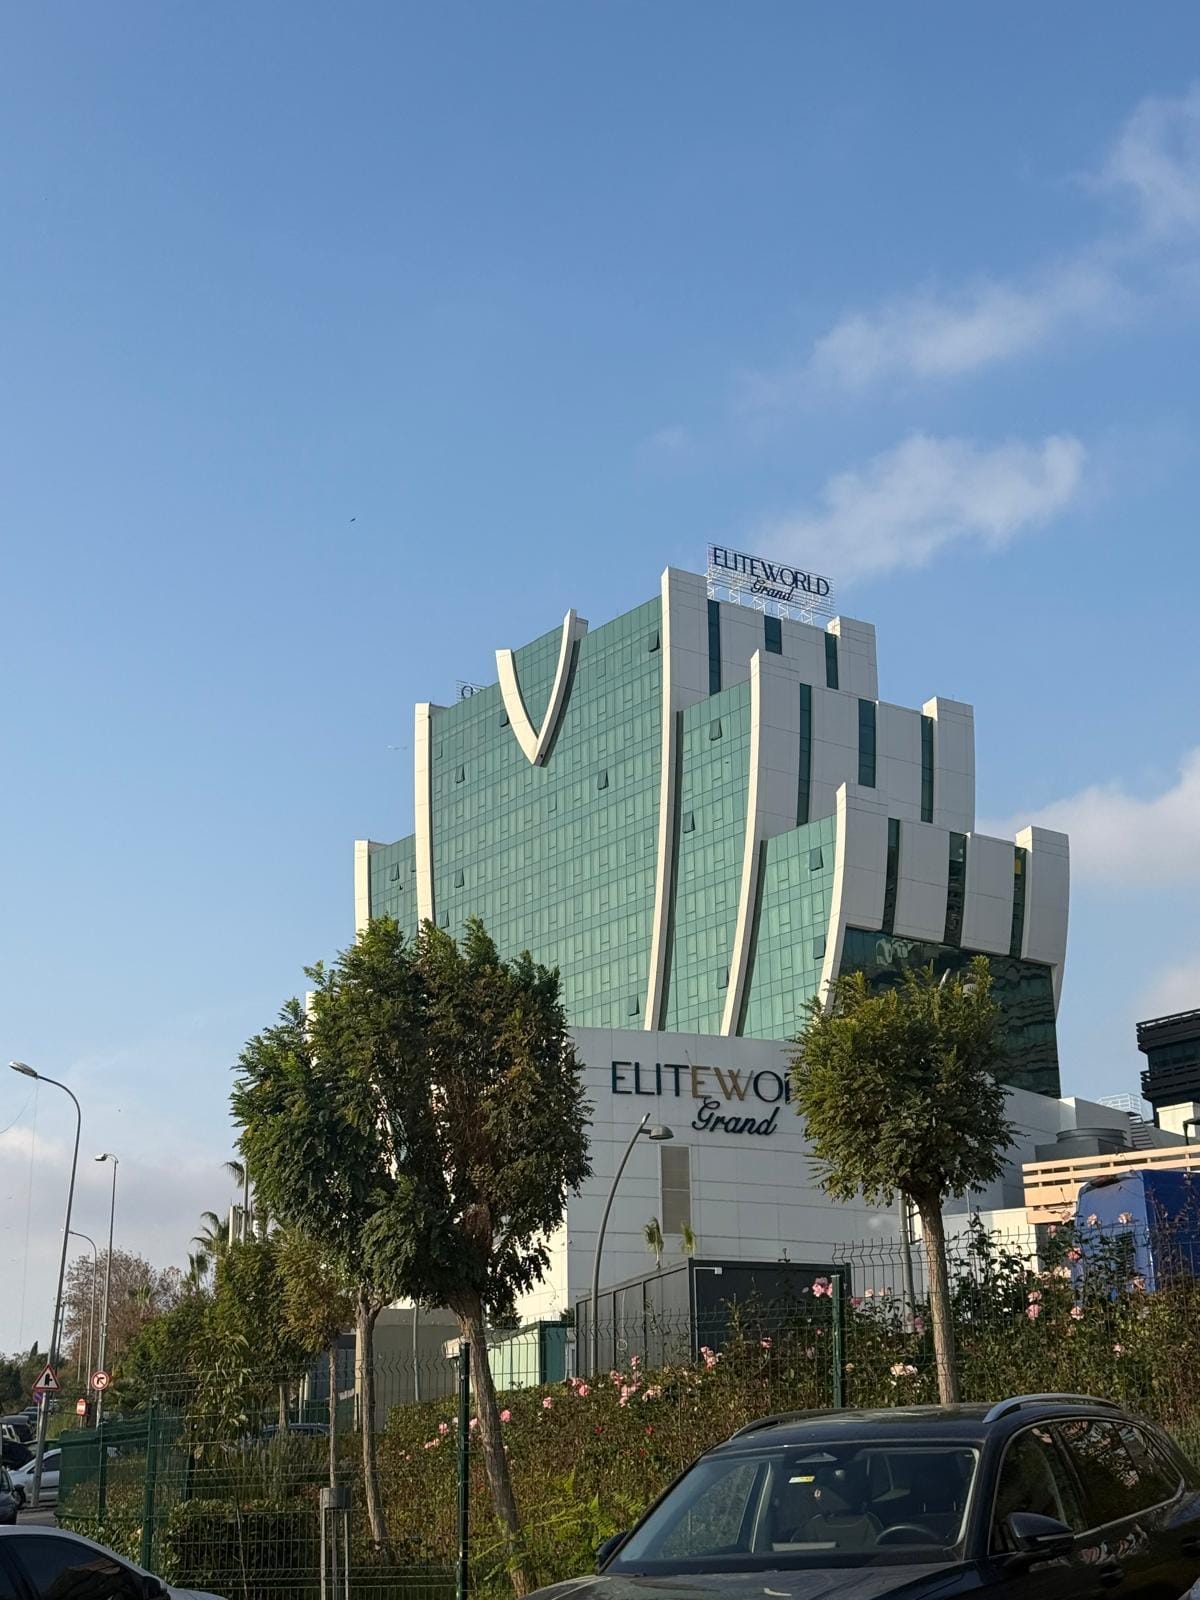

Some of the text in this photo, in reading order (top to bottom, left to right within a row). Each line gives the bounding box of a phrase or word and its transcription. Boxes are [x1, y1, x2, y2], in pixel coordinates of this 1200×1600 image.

[713, 547, 830, 597] ELITEWORLD
[750, 577, 794, 602] Grand
[691, 1097, 781, 1136] Grand
